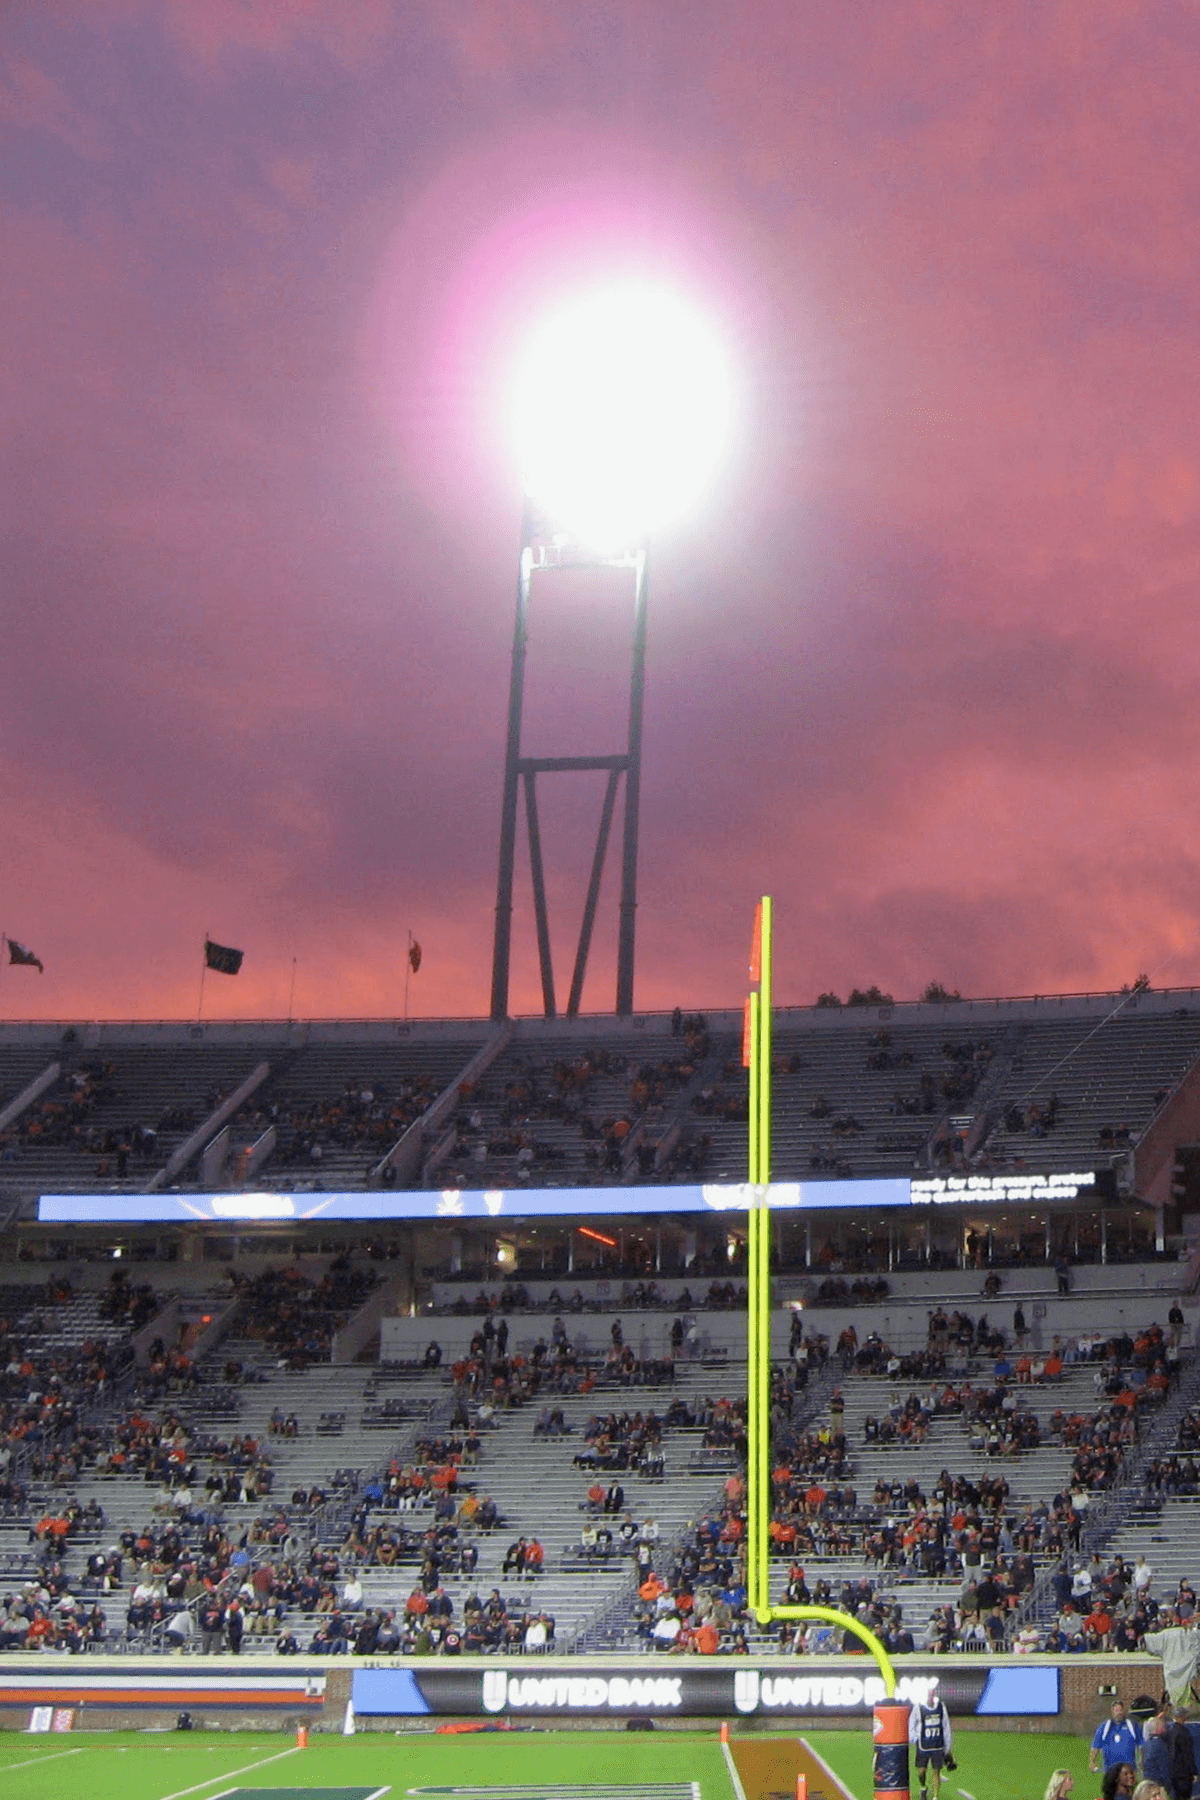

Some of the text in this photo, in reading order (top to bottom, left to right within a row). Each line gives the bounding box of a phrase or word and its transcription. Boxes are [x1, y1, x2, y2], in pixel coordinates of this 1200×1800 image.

[508, 1677, 683, 1707] UNITED BANK
[761, 1676, 863, 1707] UNITED
